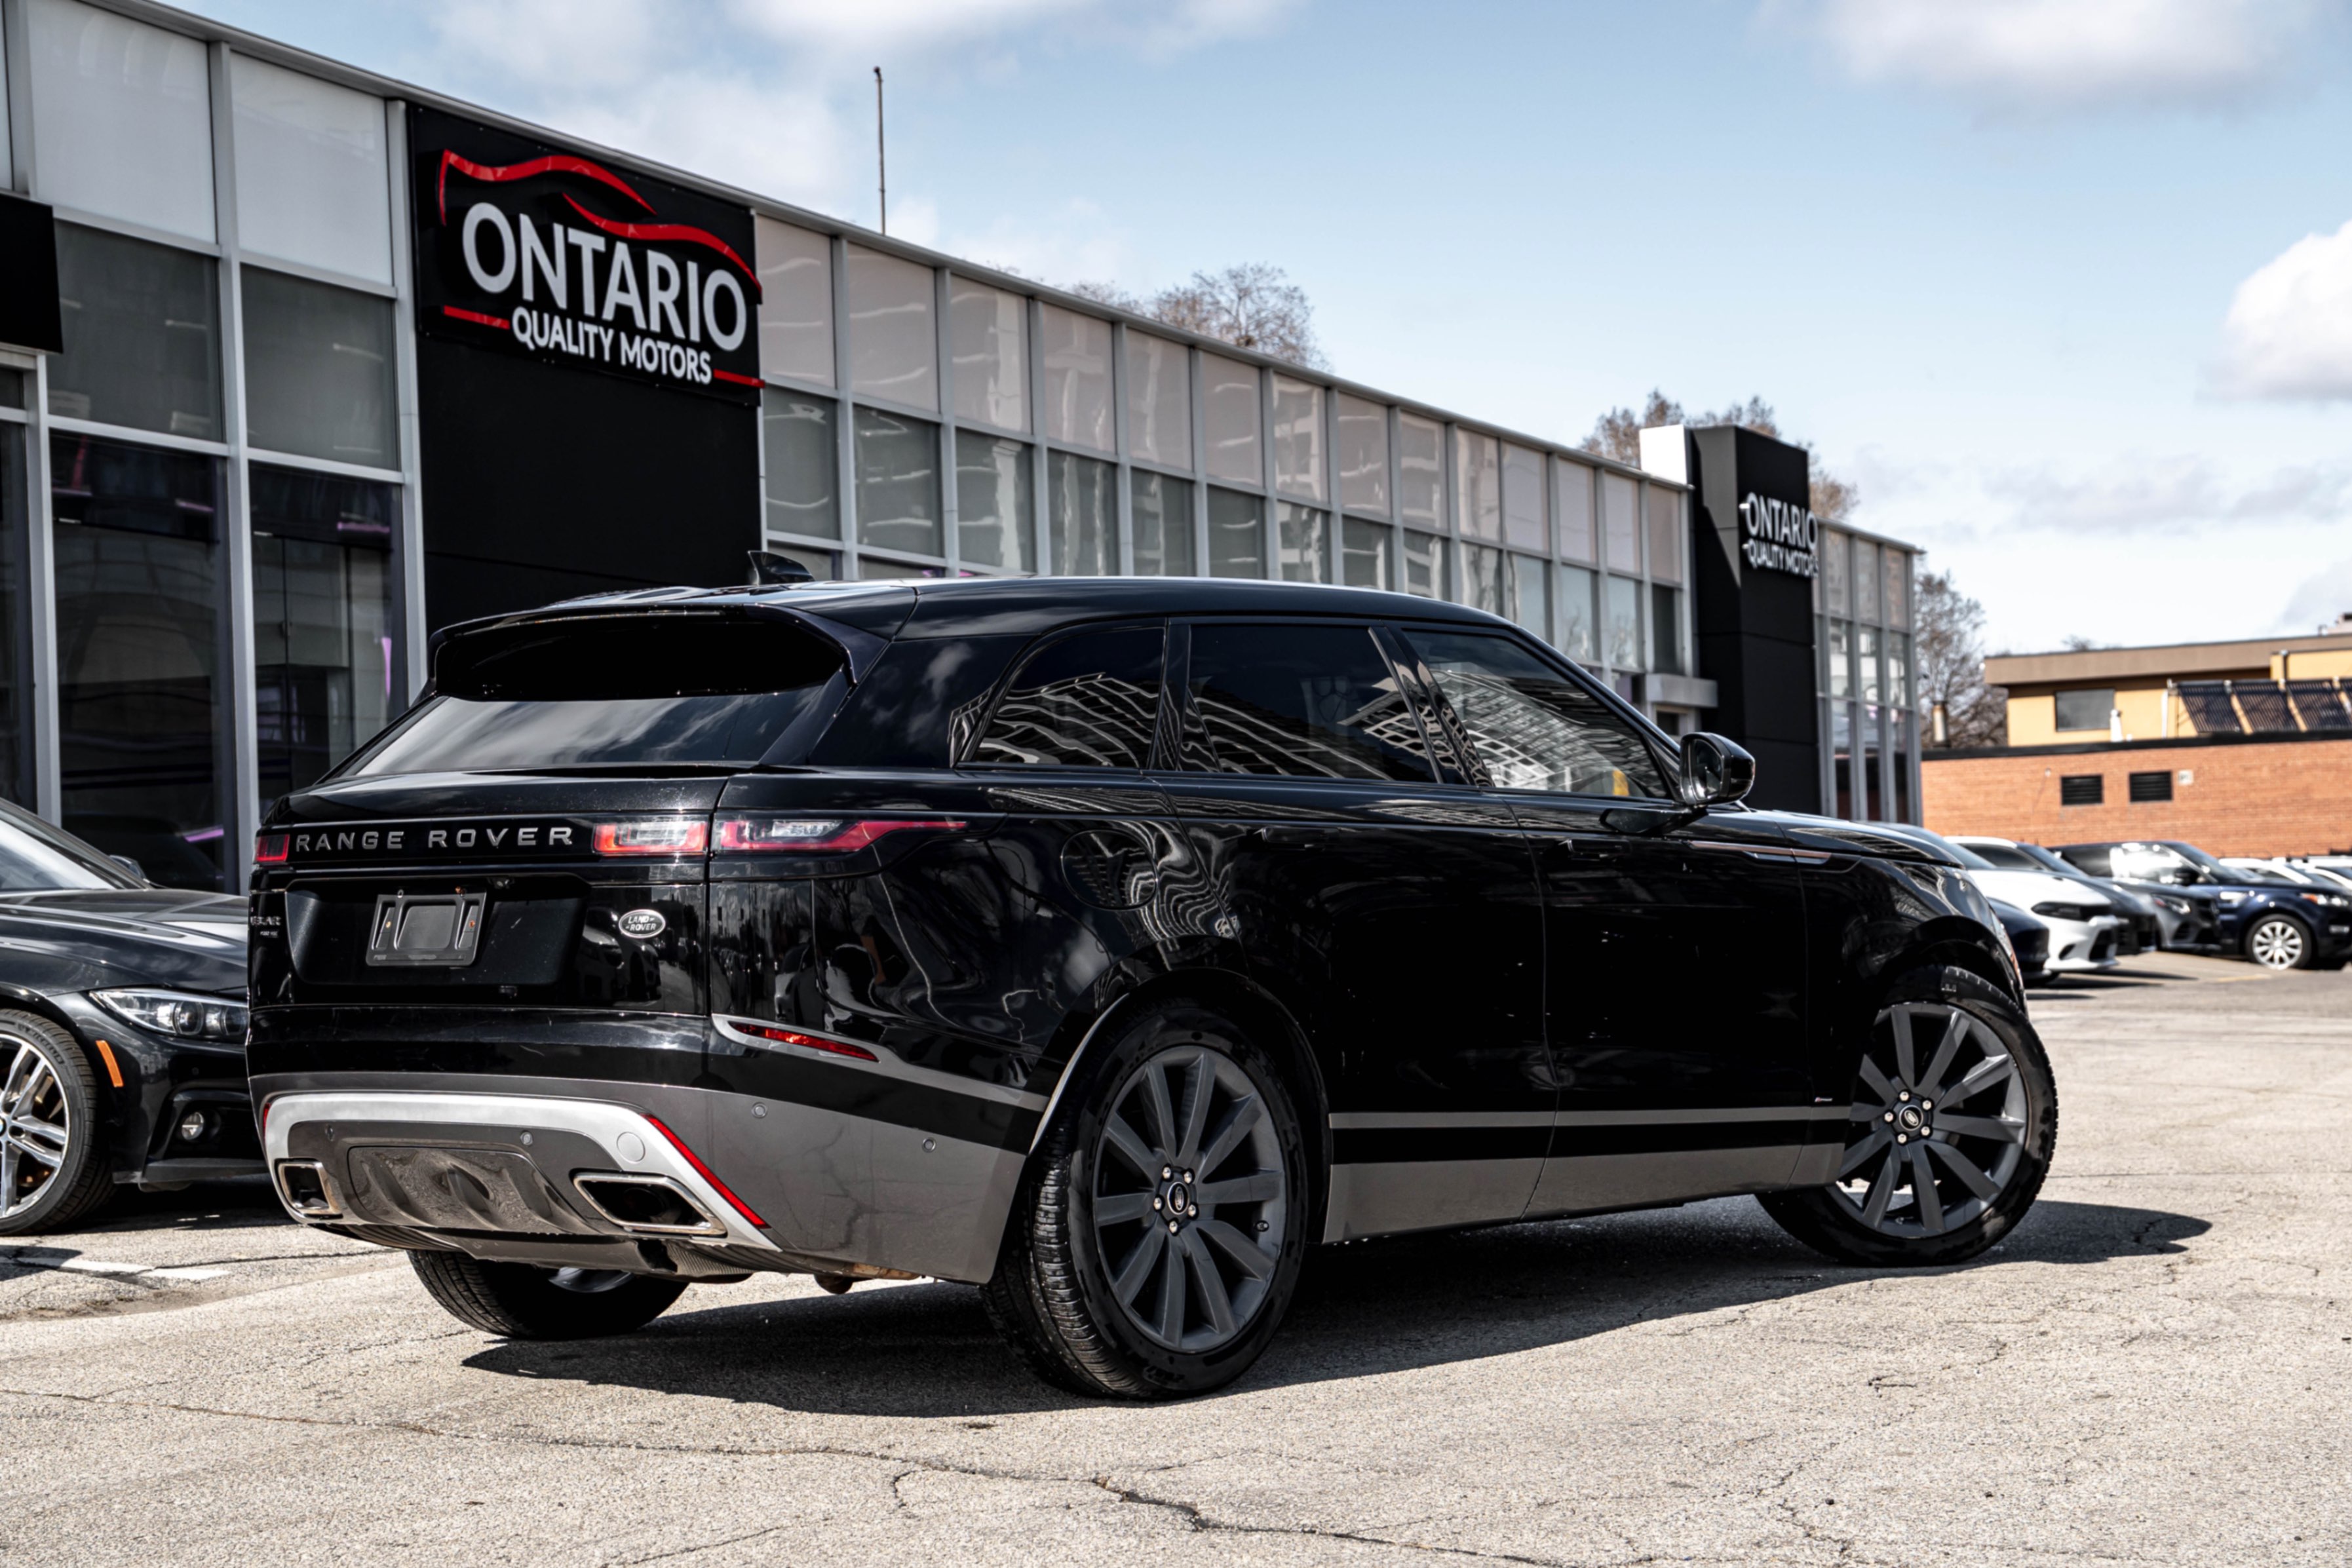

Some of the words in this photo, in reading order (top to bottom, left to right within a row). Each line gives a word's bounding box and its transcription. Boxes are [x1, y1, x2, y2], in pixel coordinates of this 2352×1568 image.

[463, 202, 747, 351] ONTARIO
[512, 306, 615, 362] QUALITY
[620, 332, 712, 384] MOTORS
[1745, 492, 1818, 550] ONTARIO
[1747, 538, 1783, 569] QUALITY
[1784, 548, 1819, 578] MOTORS
[296, 831, 404, 852] RANGE
[428, 828, 573, 848] ROVER
[628, 915, 649, 924] LAND
